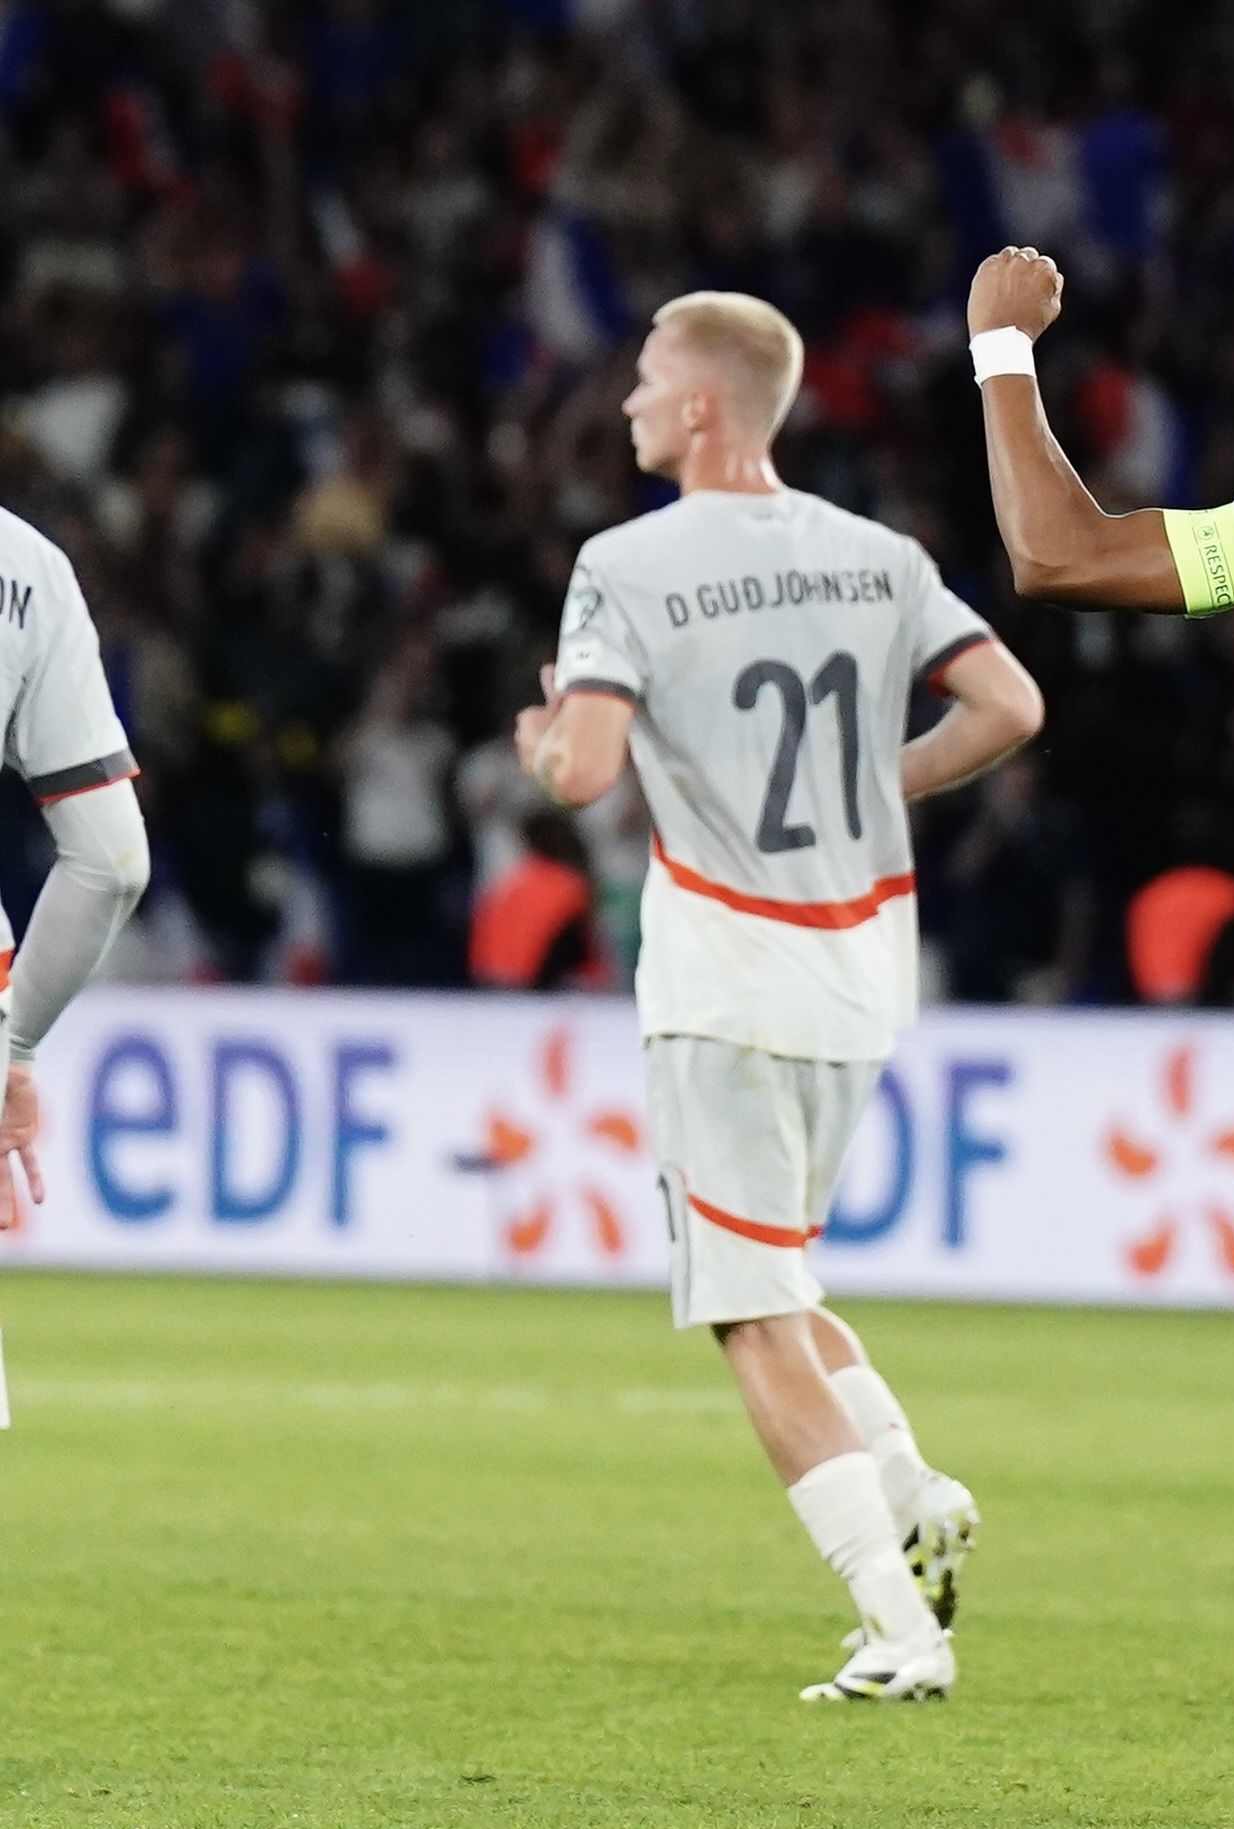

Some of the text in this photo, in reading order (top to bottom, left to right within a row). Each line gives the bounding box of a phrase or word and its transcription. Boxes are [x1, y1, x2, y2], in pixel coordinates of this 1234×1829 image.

[665, 592, 690, 628] D
[1204, 545, 1233, 606] RESPEC
[731, 650, 863, 855] 21
[822, 1060, 1014, 1248] DF
